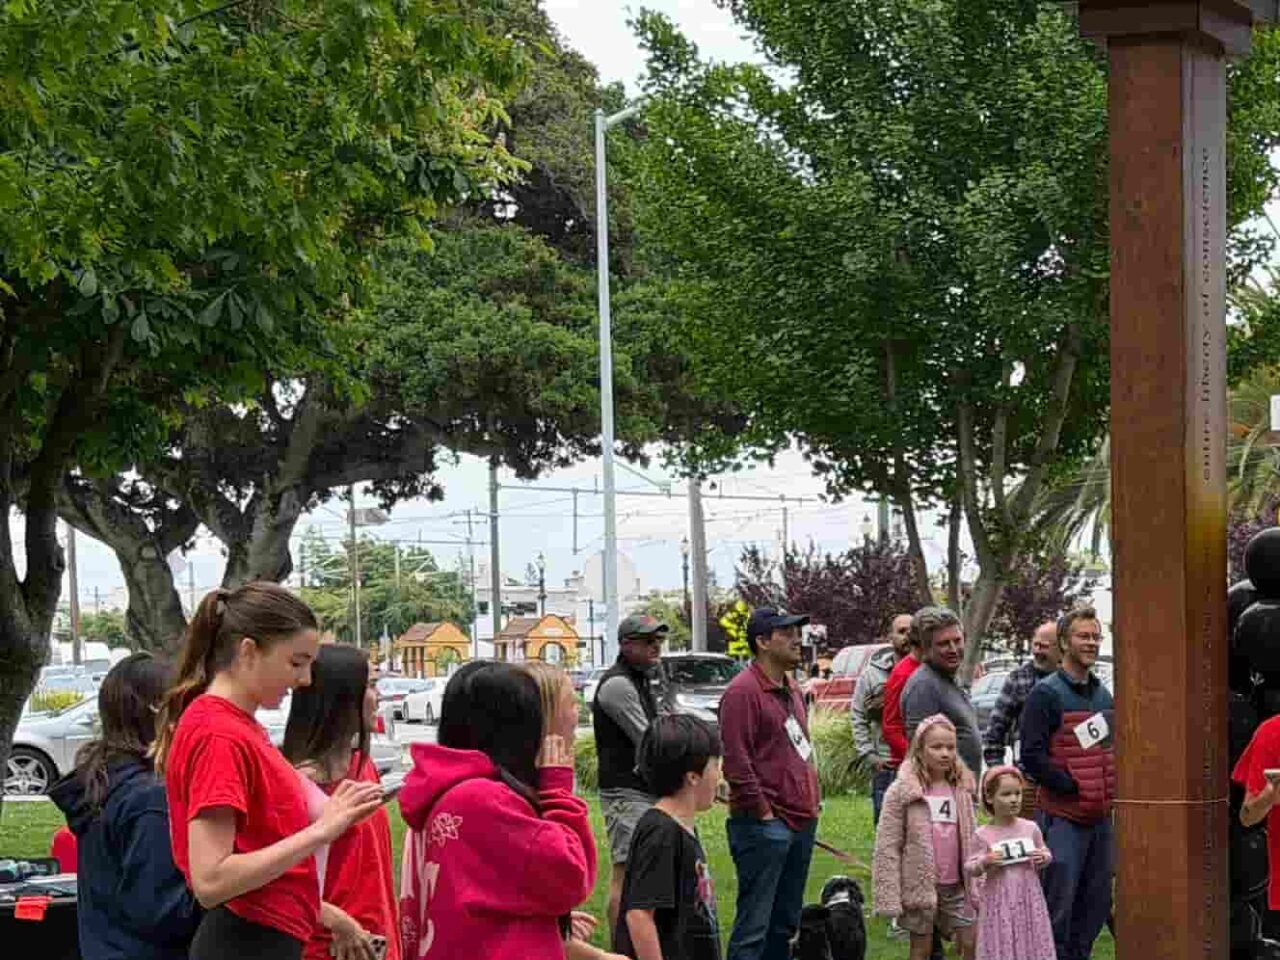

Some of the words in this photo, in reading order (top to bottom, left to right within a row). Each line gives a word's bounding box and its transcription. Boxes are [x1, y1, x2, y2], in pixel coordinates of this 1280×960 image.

[1201, 147, 1210, 282] conscience
[1200, 292, 1210, 316] of
[1199, 331, 1211, 402] liberty
[1087, 721, 1100, 740] 6
[938, 800, 951, 818] 4
[1001, 840, 1026, 860] 11
